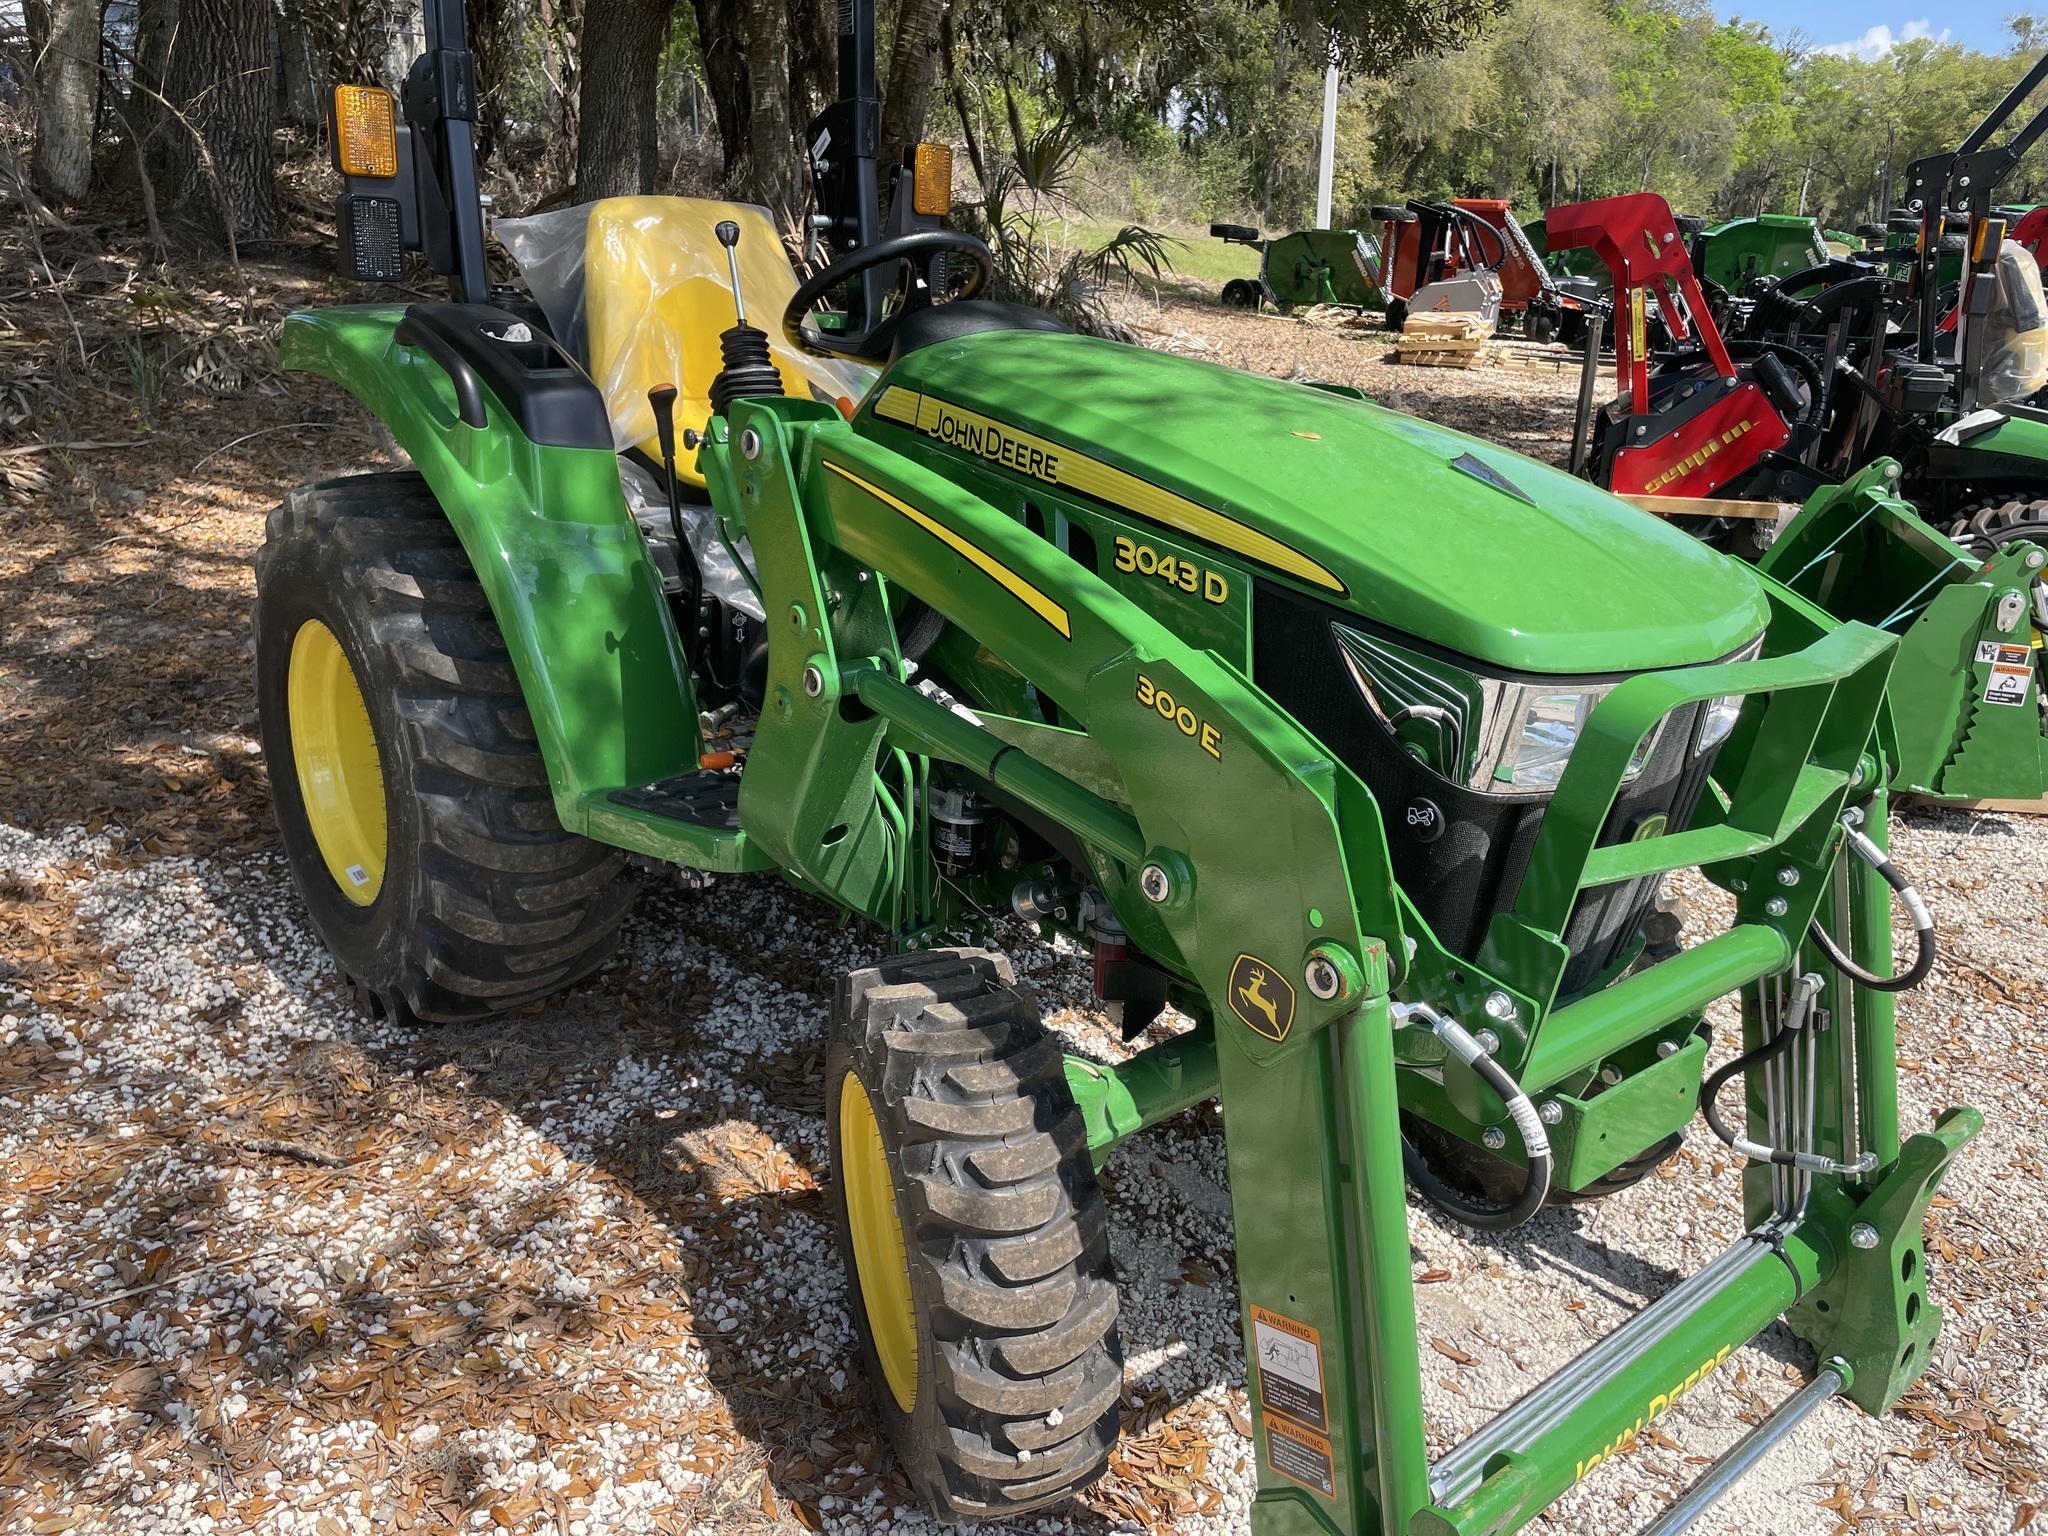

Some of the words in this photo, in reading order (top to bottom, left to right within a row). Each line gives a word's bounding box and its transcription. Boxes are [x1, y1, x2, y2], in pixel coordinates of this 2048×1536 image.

[930, 408, 983, 452] JOHN
[986, 425, 1059, 480] DEERE
[1644, 438, 1720, 494] seppi
[1268, 1314, 1311, 1339] WARNING
[1280, 1424, 1324, 1450] WARNING
